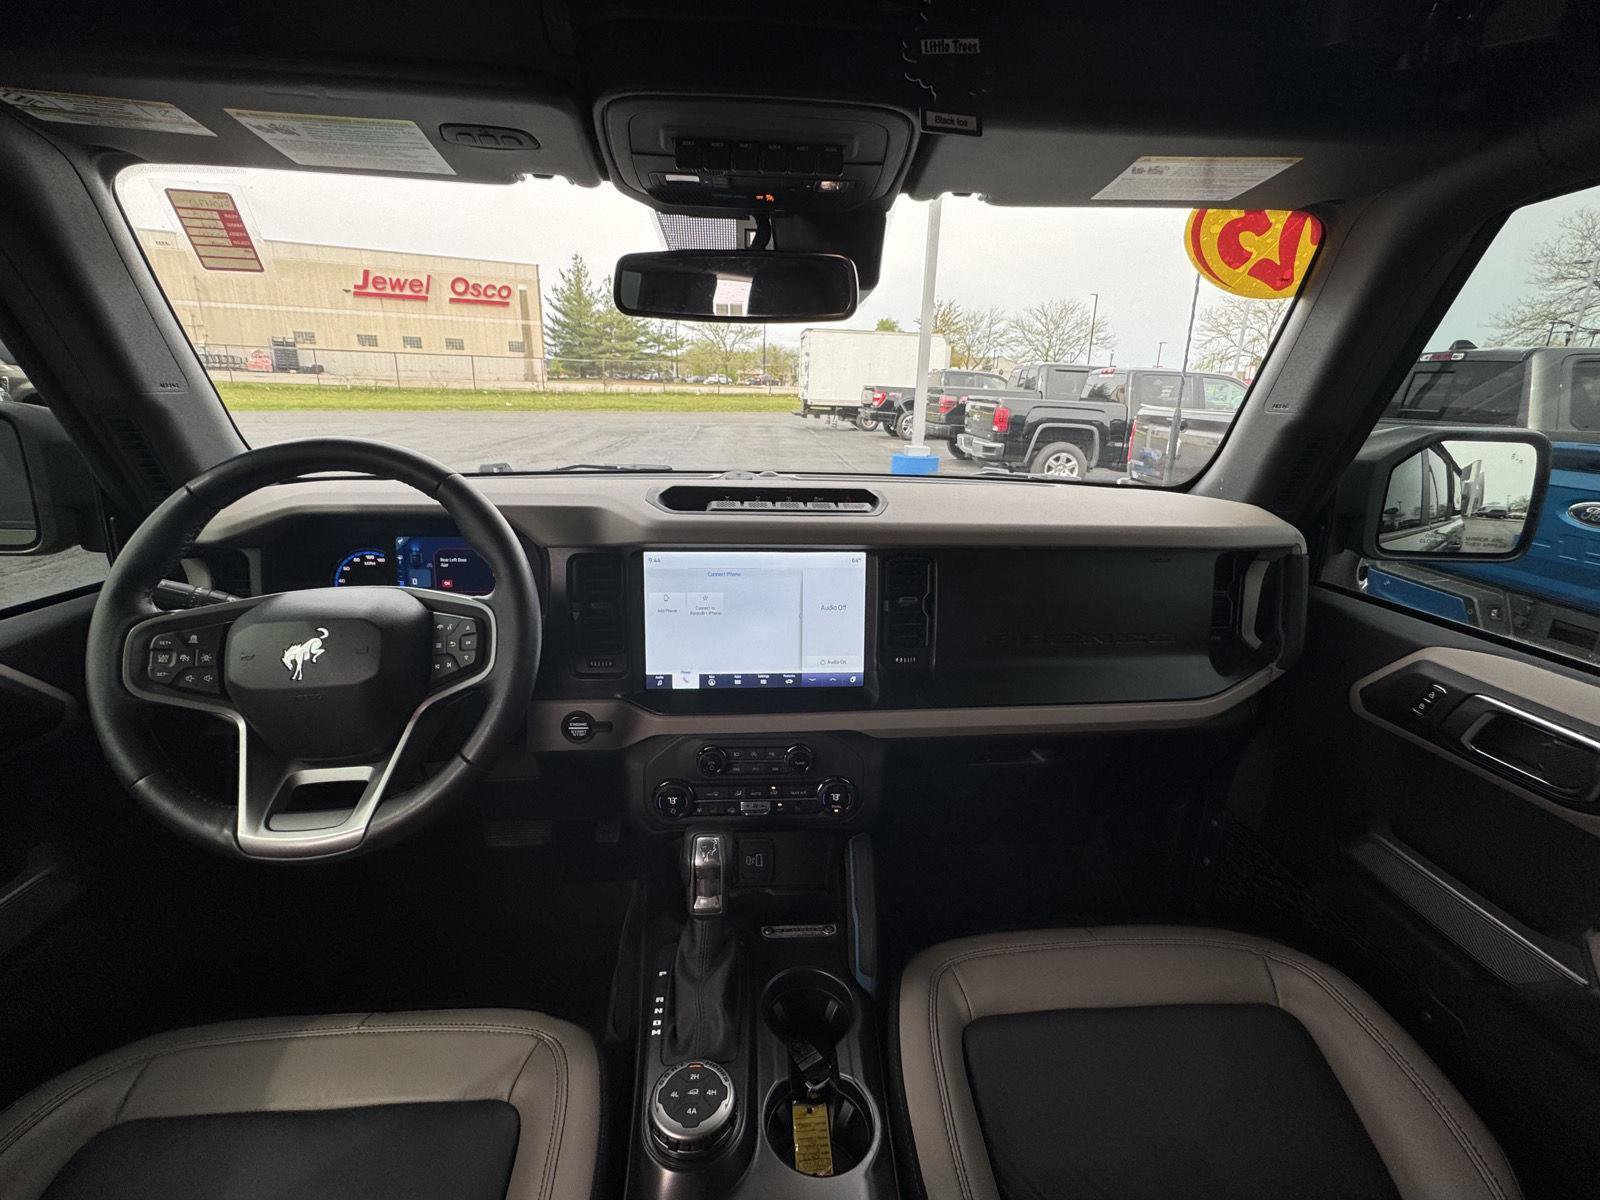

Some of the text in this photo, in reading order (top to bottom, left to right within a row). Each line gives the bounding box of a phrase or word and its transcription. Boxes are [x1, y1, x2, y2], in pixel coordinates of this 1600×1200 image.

[924, 40, 978, 53] Little Trees
[934, 115, 968, 127] Black Ice
[353, 269, 513, 300] Jewel Osco
[686, 1107, 697, 1115] 4A
